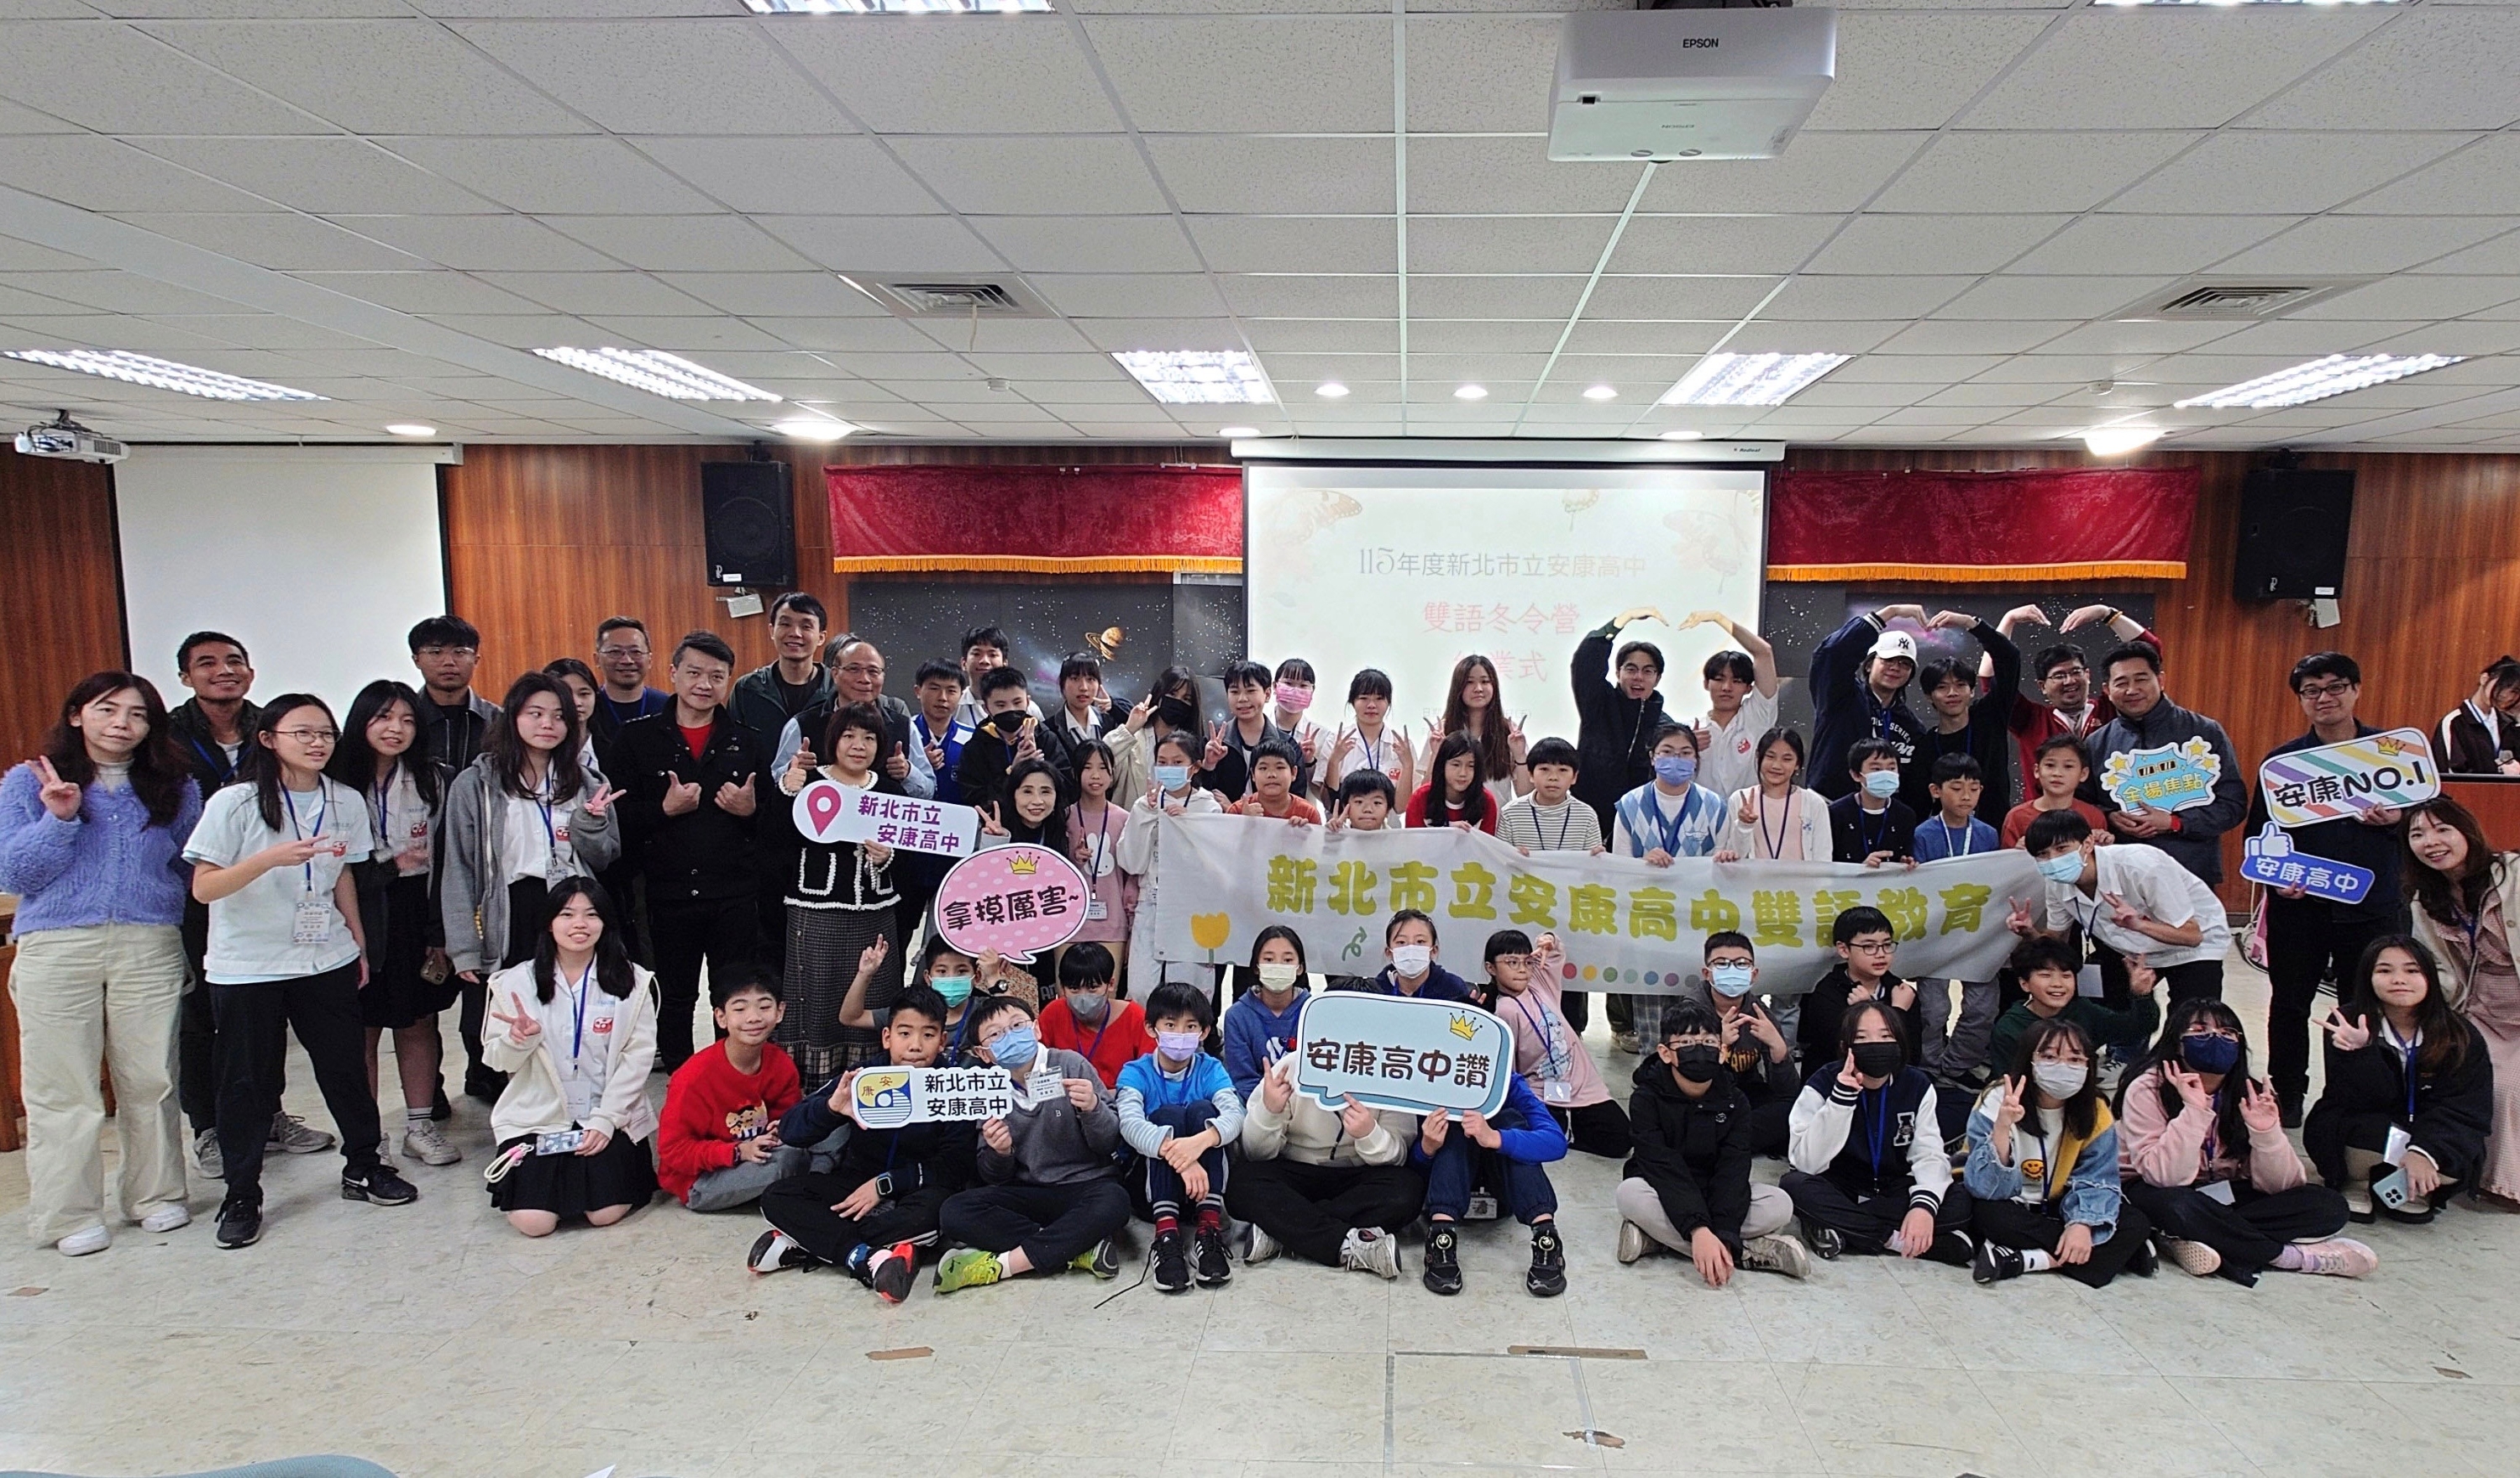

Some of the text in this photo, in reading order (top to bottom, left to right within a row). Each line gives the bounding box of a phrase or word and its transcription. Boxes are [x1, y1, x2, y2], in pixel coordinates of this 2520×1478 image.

[1683, 38, 1719, 48] EPSON
[1359, 547, 1647, 578] 115年度新北市立安康高中
[1422, 601, 1580, 635] 雙語冬令營
[1898, 637, 1909, 650] NY
[1454, 650, 1547, 682] 業式
[2122, 772, 2203, 803] 全場焦點
[2273, 760, 2426, 807] 安康NO.1
[858, 795, 942, 825] 新北市立
[877, 823, 959, 853] 安康高中
[2255, 857, 2359, 893] 安康高中
[1267, 855, 1992, 948] 新北市立安康高中雙語教育
[1306, 1038, 1490, 1089] 安康高中讚
[925, 1071, 1006, 1093] 新北市立
[927, 1096, 1008, 1118] 安康高中
[1055, 1109, 1062, 1118] B
